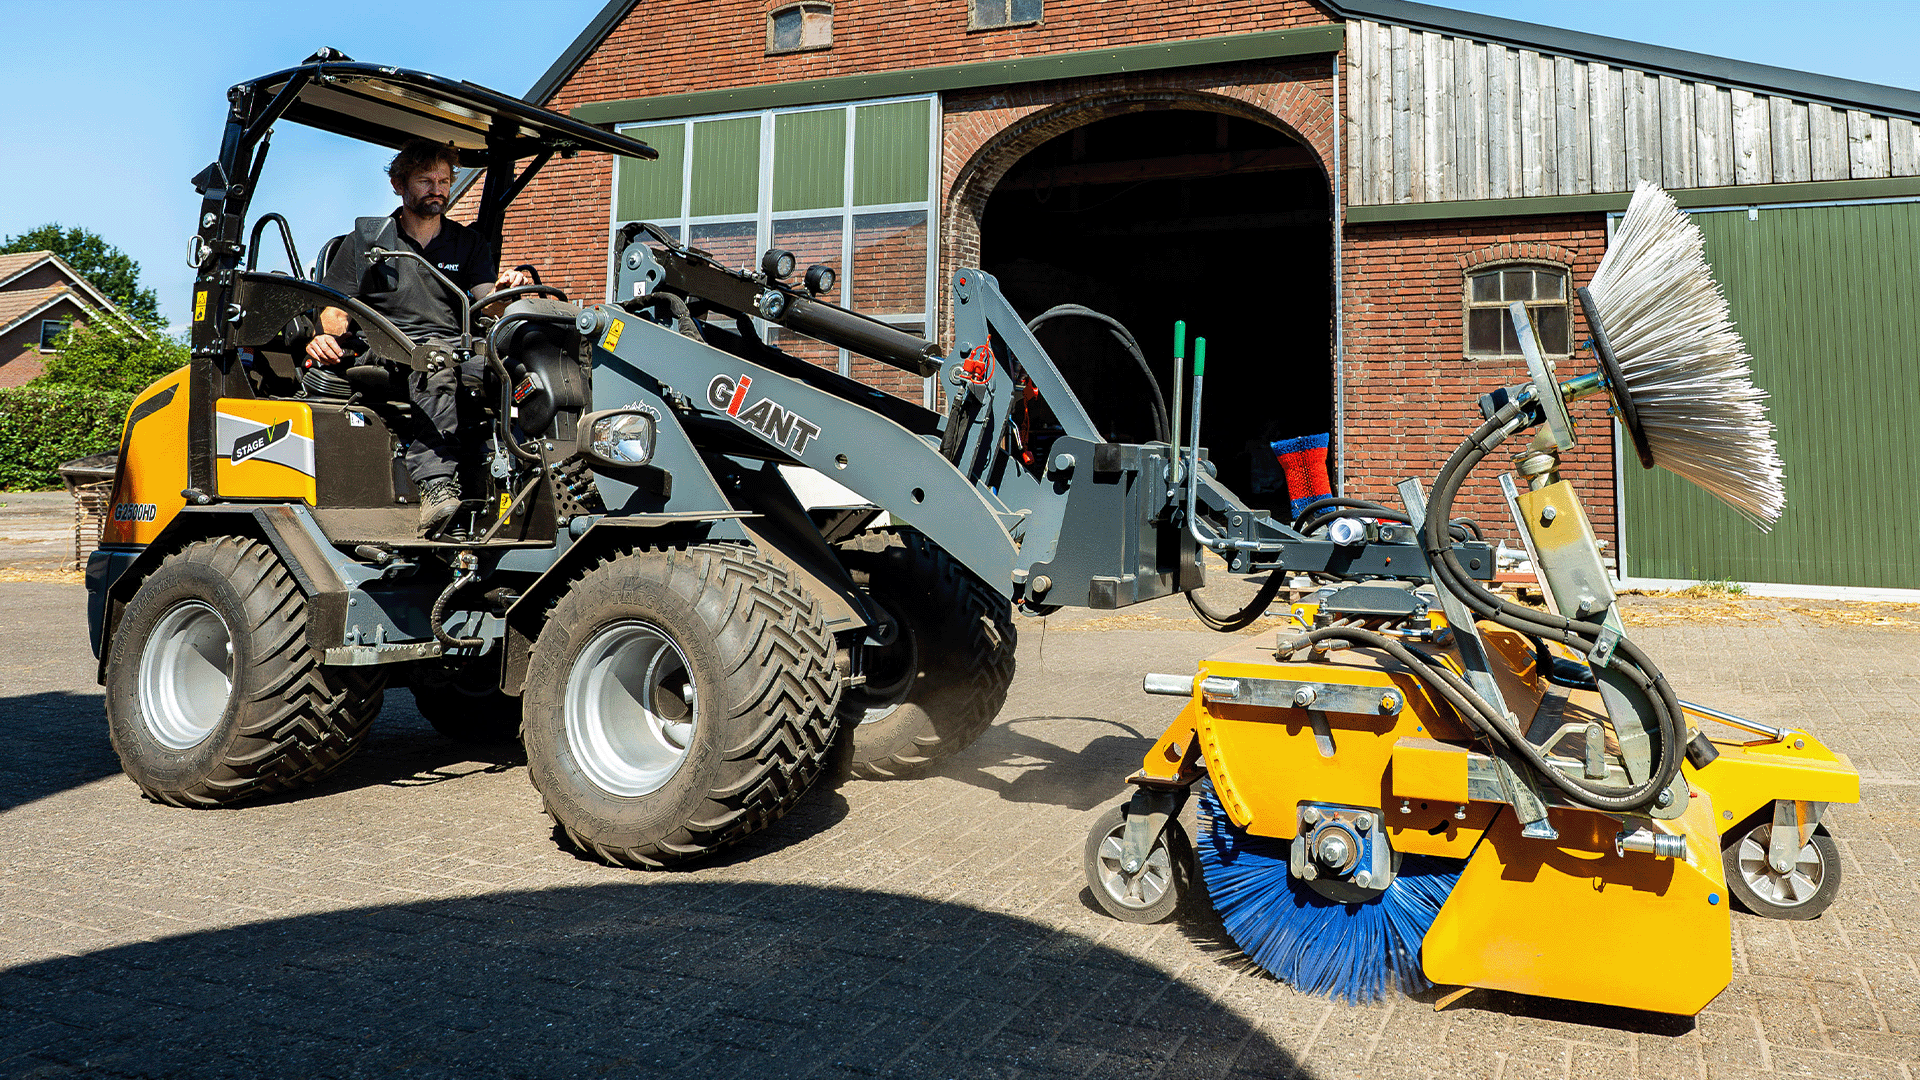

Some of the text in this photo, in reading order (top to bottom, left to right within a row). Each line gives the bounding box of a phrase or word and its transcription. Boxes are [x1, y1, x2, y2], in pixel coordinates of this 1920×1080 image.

[706, 373, 822, 457] GIANT
[236, 437, 265, 458] STAGE
[114, 502, 157, 522] G2500HD
